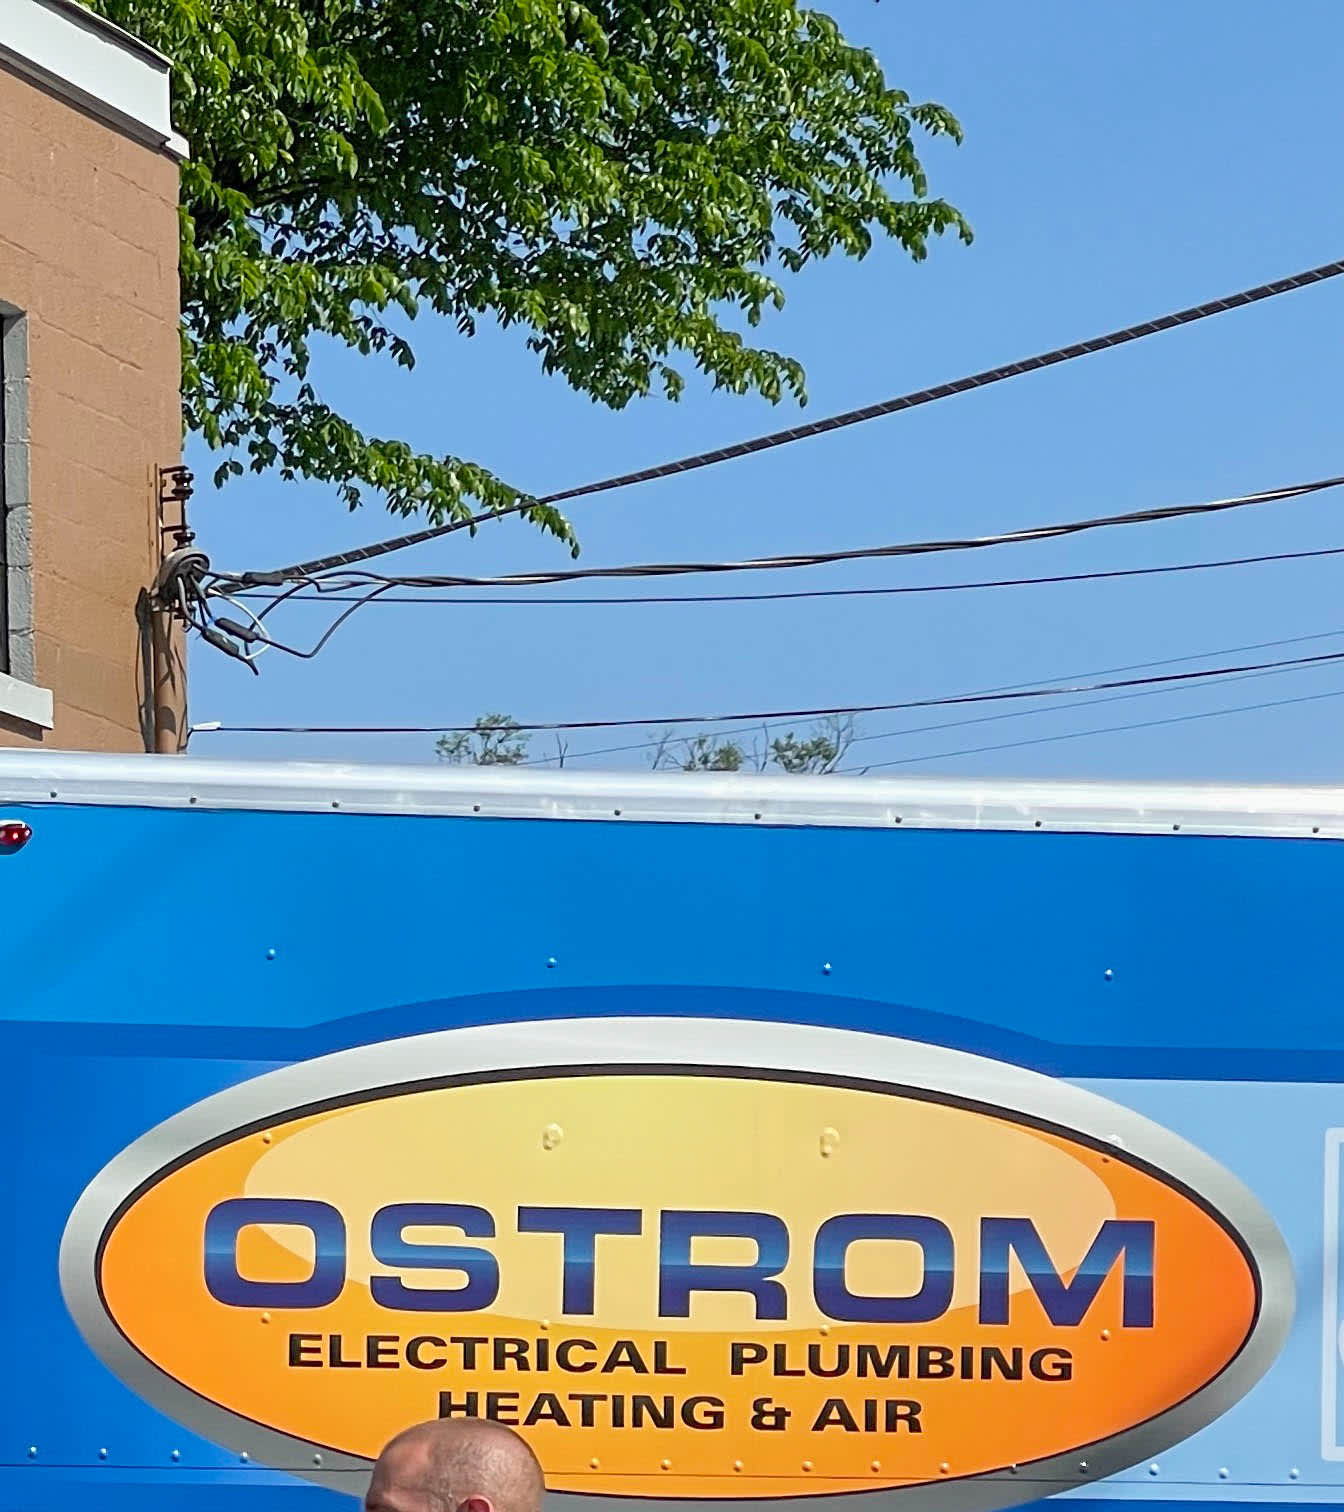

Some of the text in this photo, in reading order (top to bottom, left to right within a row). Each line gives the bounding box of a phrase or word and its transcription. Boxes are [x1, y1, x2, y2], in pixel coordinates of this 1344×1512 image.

[203, 1197, 1156, 1329] OSTROM
[288, 1333, 1074, 1382] ELECTRICAL PLUMBING
[438, 1391, 923, 1433] HEATING & AIR
